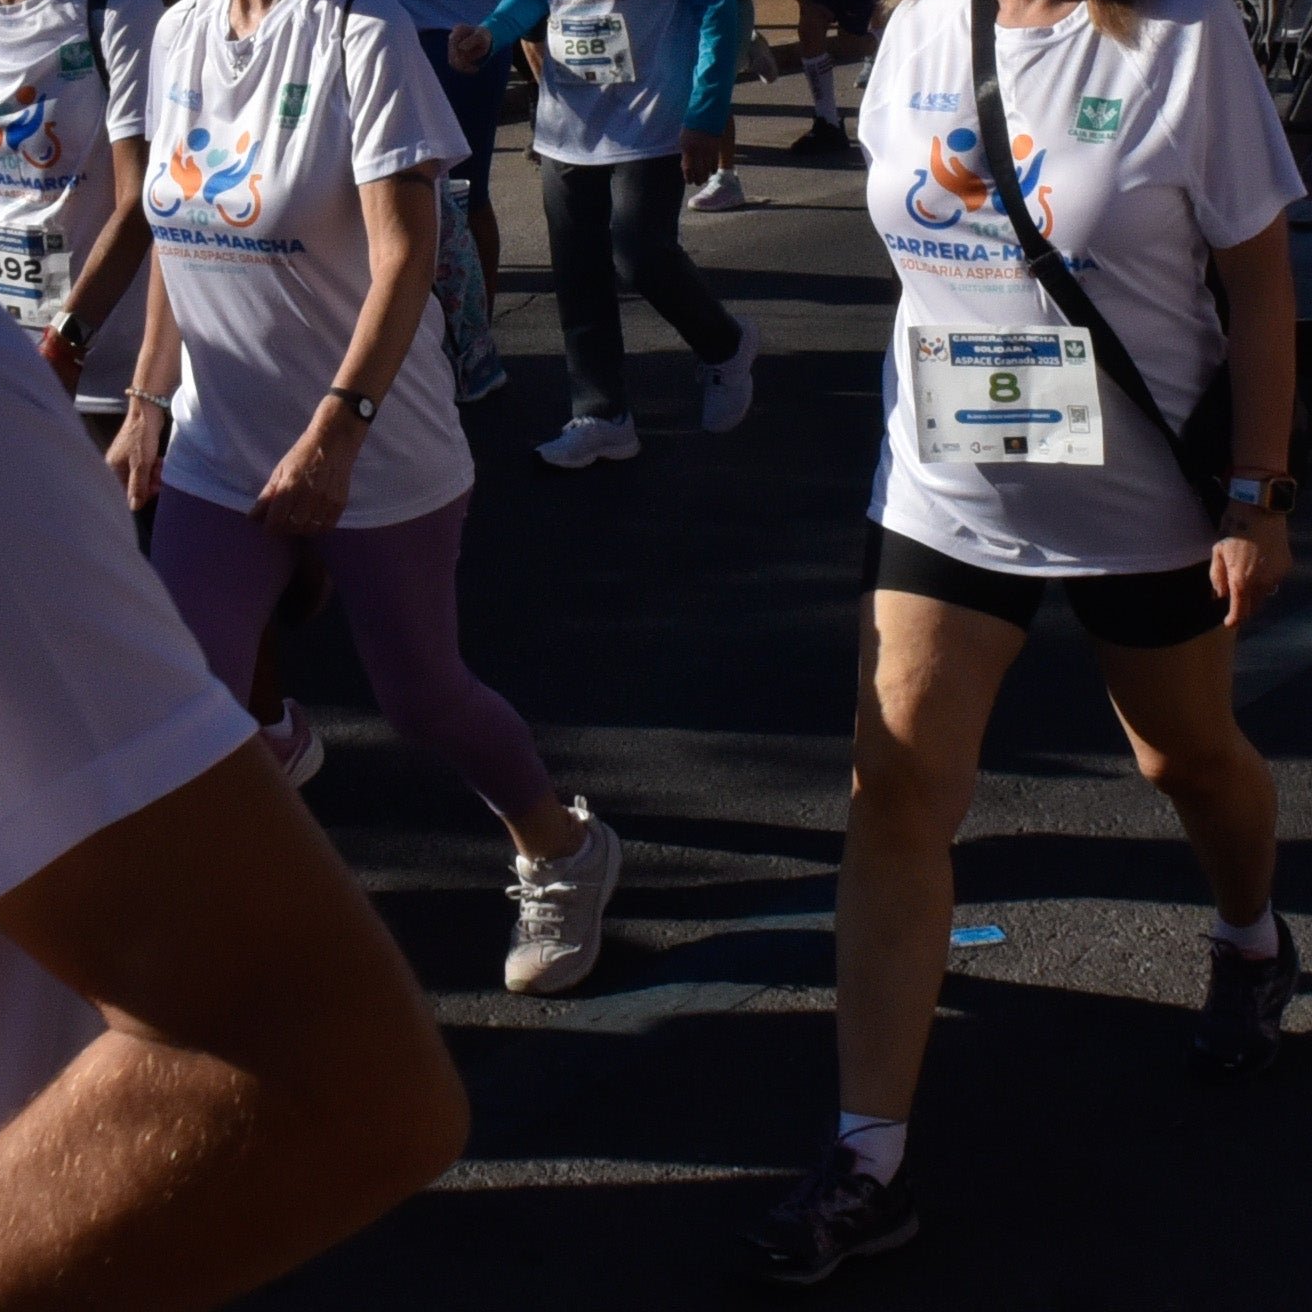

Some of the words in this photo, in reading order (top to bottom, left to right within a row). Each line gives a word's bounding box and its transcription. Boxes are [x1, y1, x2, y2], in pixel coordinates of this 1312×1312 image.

[564, 39, 607, 55] 268
[885, 233, 1099, 273] CARRERA-MHA
[899, 258, 964, 281] SOLIDARIA
[965, 265, 1023, 280] ASPACE
[952, 334, 1057, 344] CARRERA-MARCHA
[973, 345, 1033, 354] SOLIDARIA
[954, 356, 992, 366] ASPACE
[994, 356, 1036, 366] Granada
[1037, 356, 1061, 366] 2025
[989, 372, 1022, 403] 8
